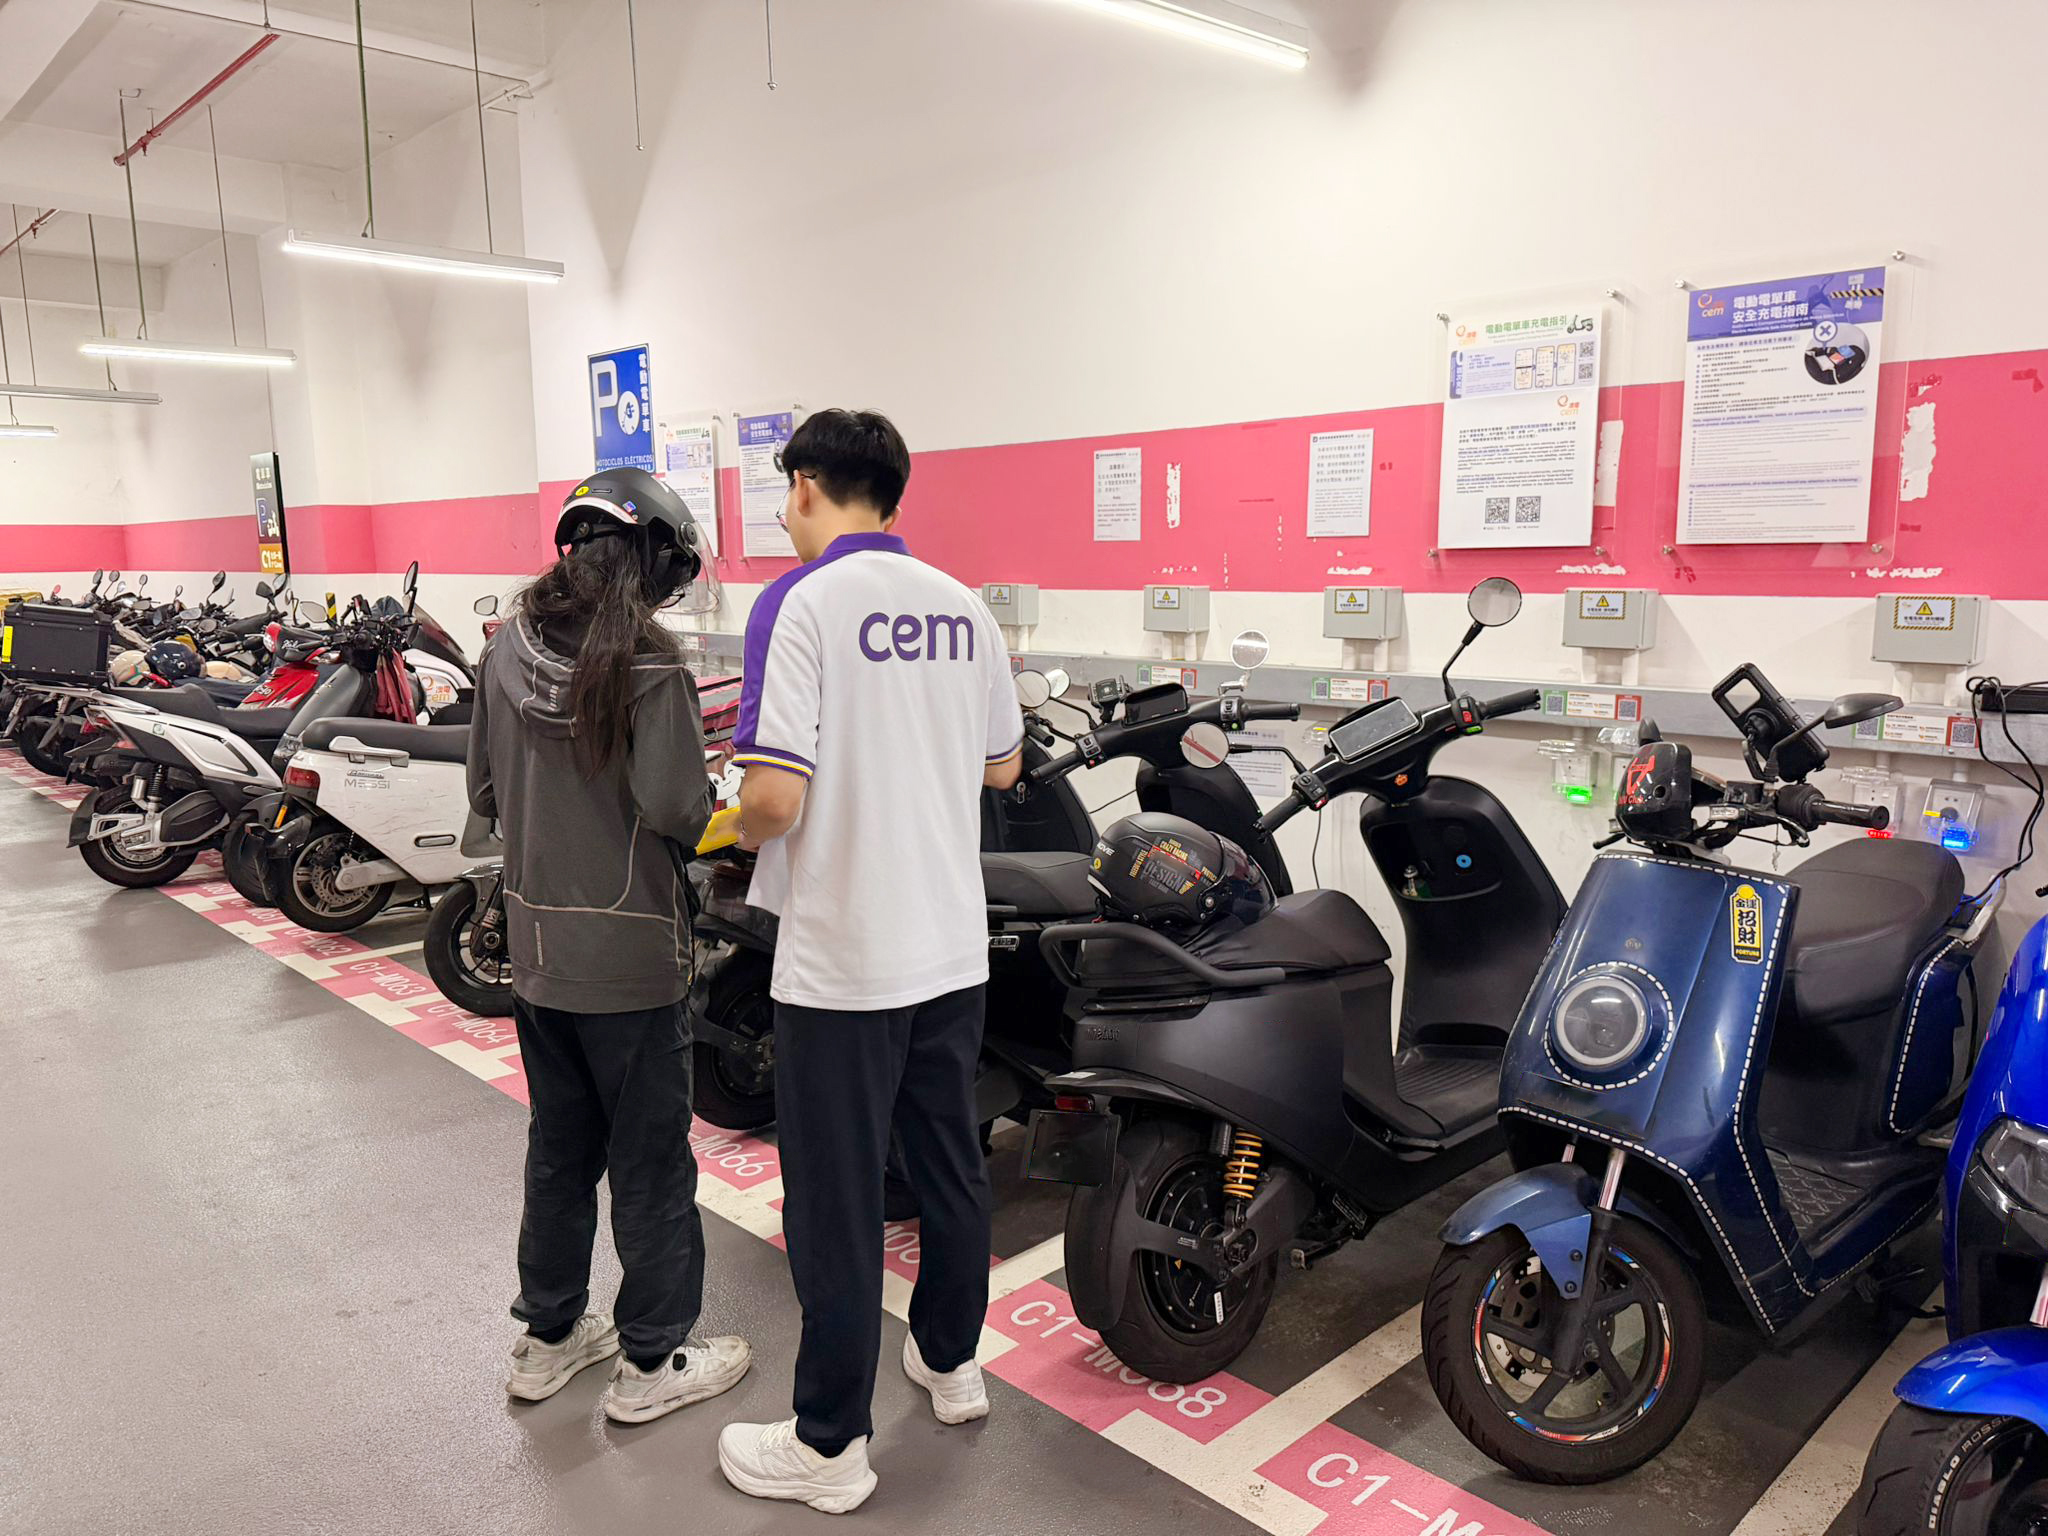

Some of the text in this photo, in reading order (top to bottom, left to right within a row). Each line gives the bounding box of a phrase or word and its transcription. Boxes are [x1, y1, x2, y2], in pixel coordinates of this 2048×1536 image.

[1702, 306, 1725, 318] cem
[1732, 303, 1809, 325] 安全充電指南
[1733, 290, 1797, 310] 電動電單車
[1485, 315, 1568, 334] 電動電單車充電指引
[592, 360, 619, 438] P
[859, 612, 974, 662] cem
[1142, 860, 1184, 894] DESIGN
[1737, 909, 1757, 945] 招財
[350, 961, 427, 996] C1-M063
[427, 1004, 518, 1045] C1-M064
[688, 1122, 777, 1177] -M066
[1928, 1454, 1961, 1529] DIABLO
